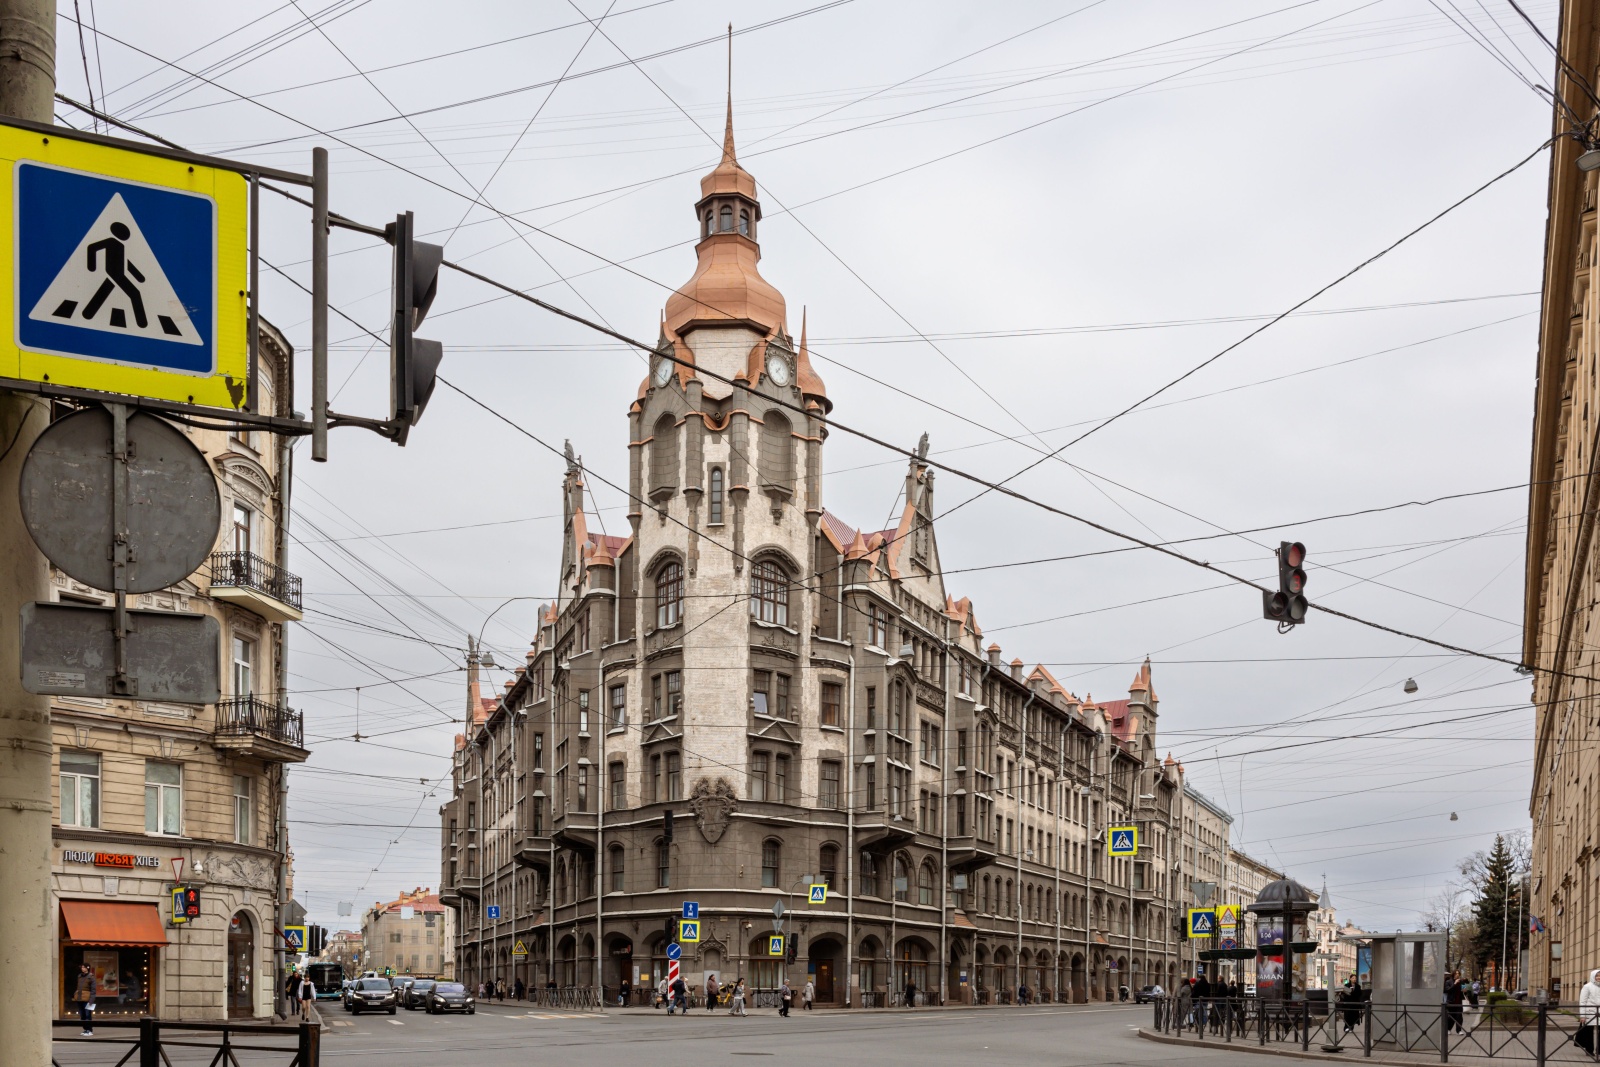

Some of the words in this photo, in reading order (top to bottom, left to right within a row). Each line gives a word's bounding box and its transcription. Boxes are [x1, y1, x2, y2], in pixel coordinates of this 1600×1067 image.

[64, 850, 95, 863] ЛЮДИ
[95, 852, 135, 865] ЛЮБЯТ
[136, 855, 161, 867] ХЛЕБ
